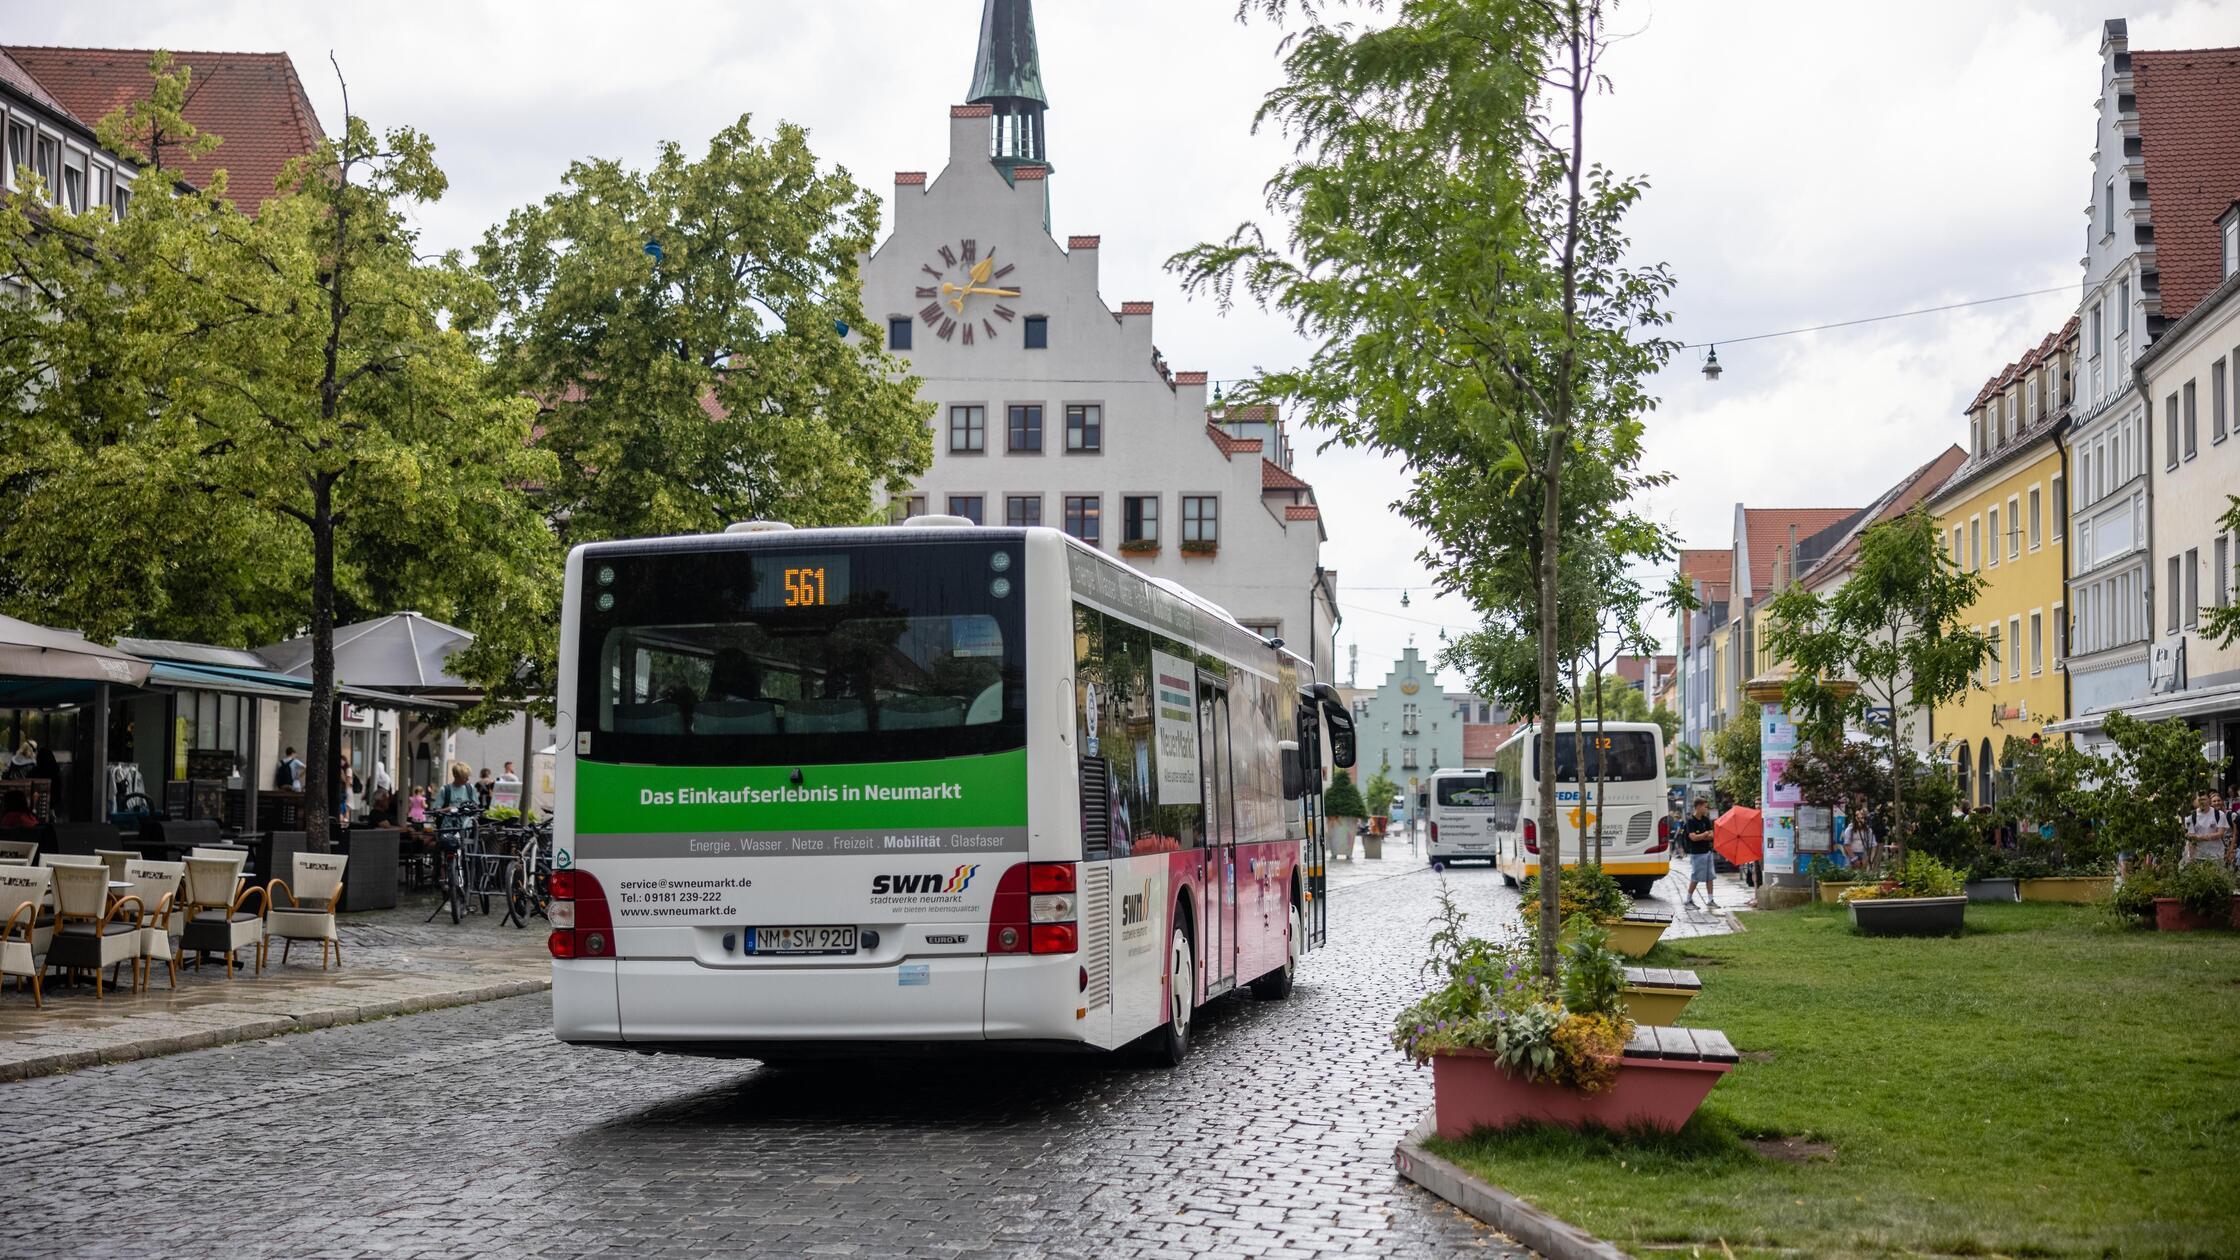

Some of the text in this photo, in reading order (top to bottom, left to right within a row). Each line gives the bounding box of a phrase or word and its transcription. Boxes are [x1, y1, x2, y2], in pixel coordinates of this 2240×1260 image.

[938, 245, 957, 269] XI
[961, 240, 976, 262] XII
[922, 264, 943, 281] X
[994, 263, 1016, 279] II
[915, 286, 937, 298] IX
[936, 316, 957, 342] VII
[962, 322, 974, 346] VI
[982, 318, 998, 340] V
[785, 568, 825, 606] 561
[640, 783, 962, 805] Das Einkaufserlebnis in Neumarkt
[1553, 791, 1593, 801] FEDEL
[690, 834, 1005, 854] Energie Wasser Netze Freizeit Mobilität Glasfaser
[620, 878, 752, 889] service@swneumarkt.de
[871, 873, 944, 895] swn
[621, 893, 642, 903] Tel.:
[679, 892, 722, 902] 239-222
[870, 895, 962, 905] stadtwerke neumarkt
[620, 906, 737, 916] www.swneumarkt.de
[1122, 892, 1143, 927] swn
[757, 929, 780, 948] NM
[793, 929, 816, 948] SW
[820, 929, 852, 948] 920
[929, 935, 966, 944] EURO 6
